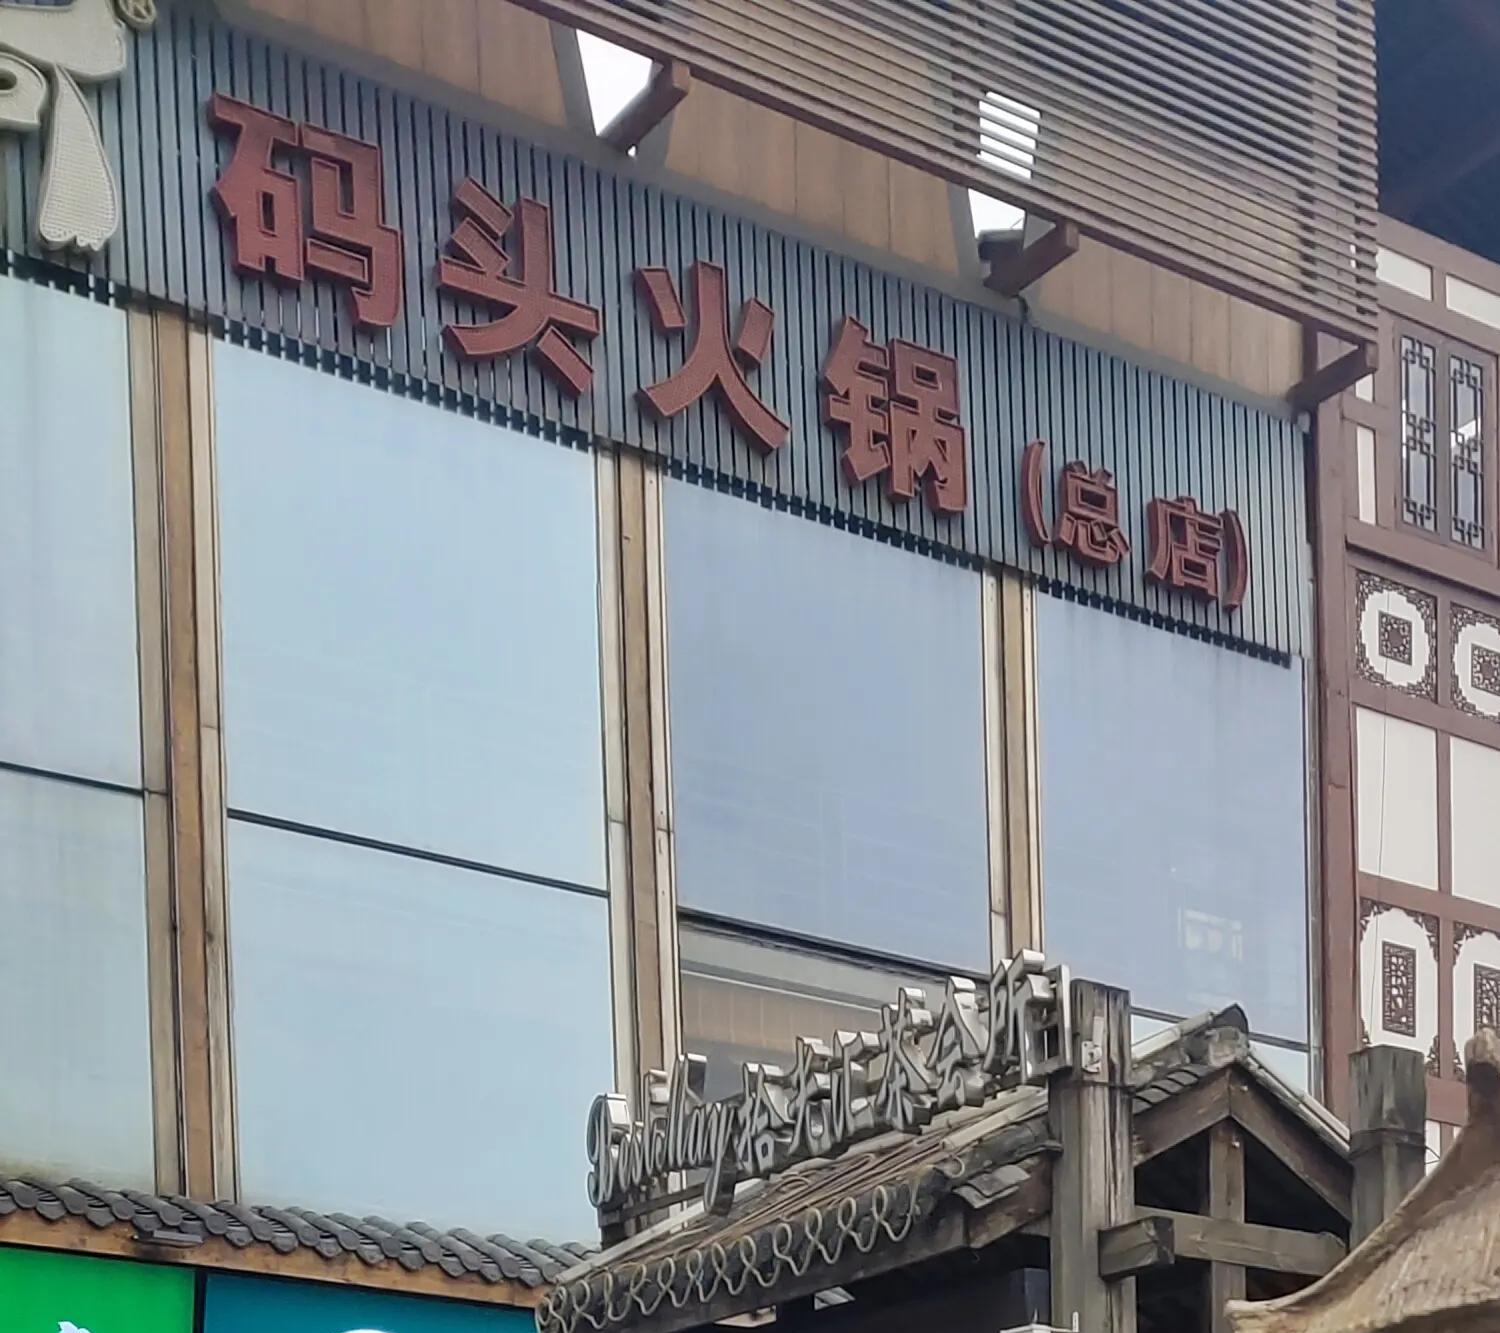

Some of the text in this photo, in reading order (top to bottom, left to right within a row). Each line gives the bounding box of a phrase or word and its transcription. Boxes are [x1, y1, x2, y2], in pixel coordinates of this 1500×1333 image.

[207, 91, 1248, 613] 码头火锅(总店)
